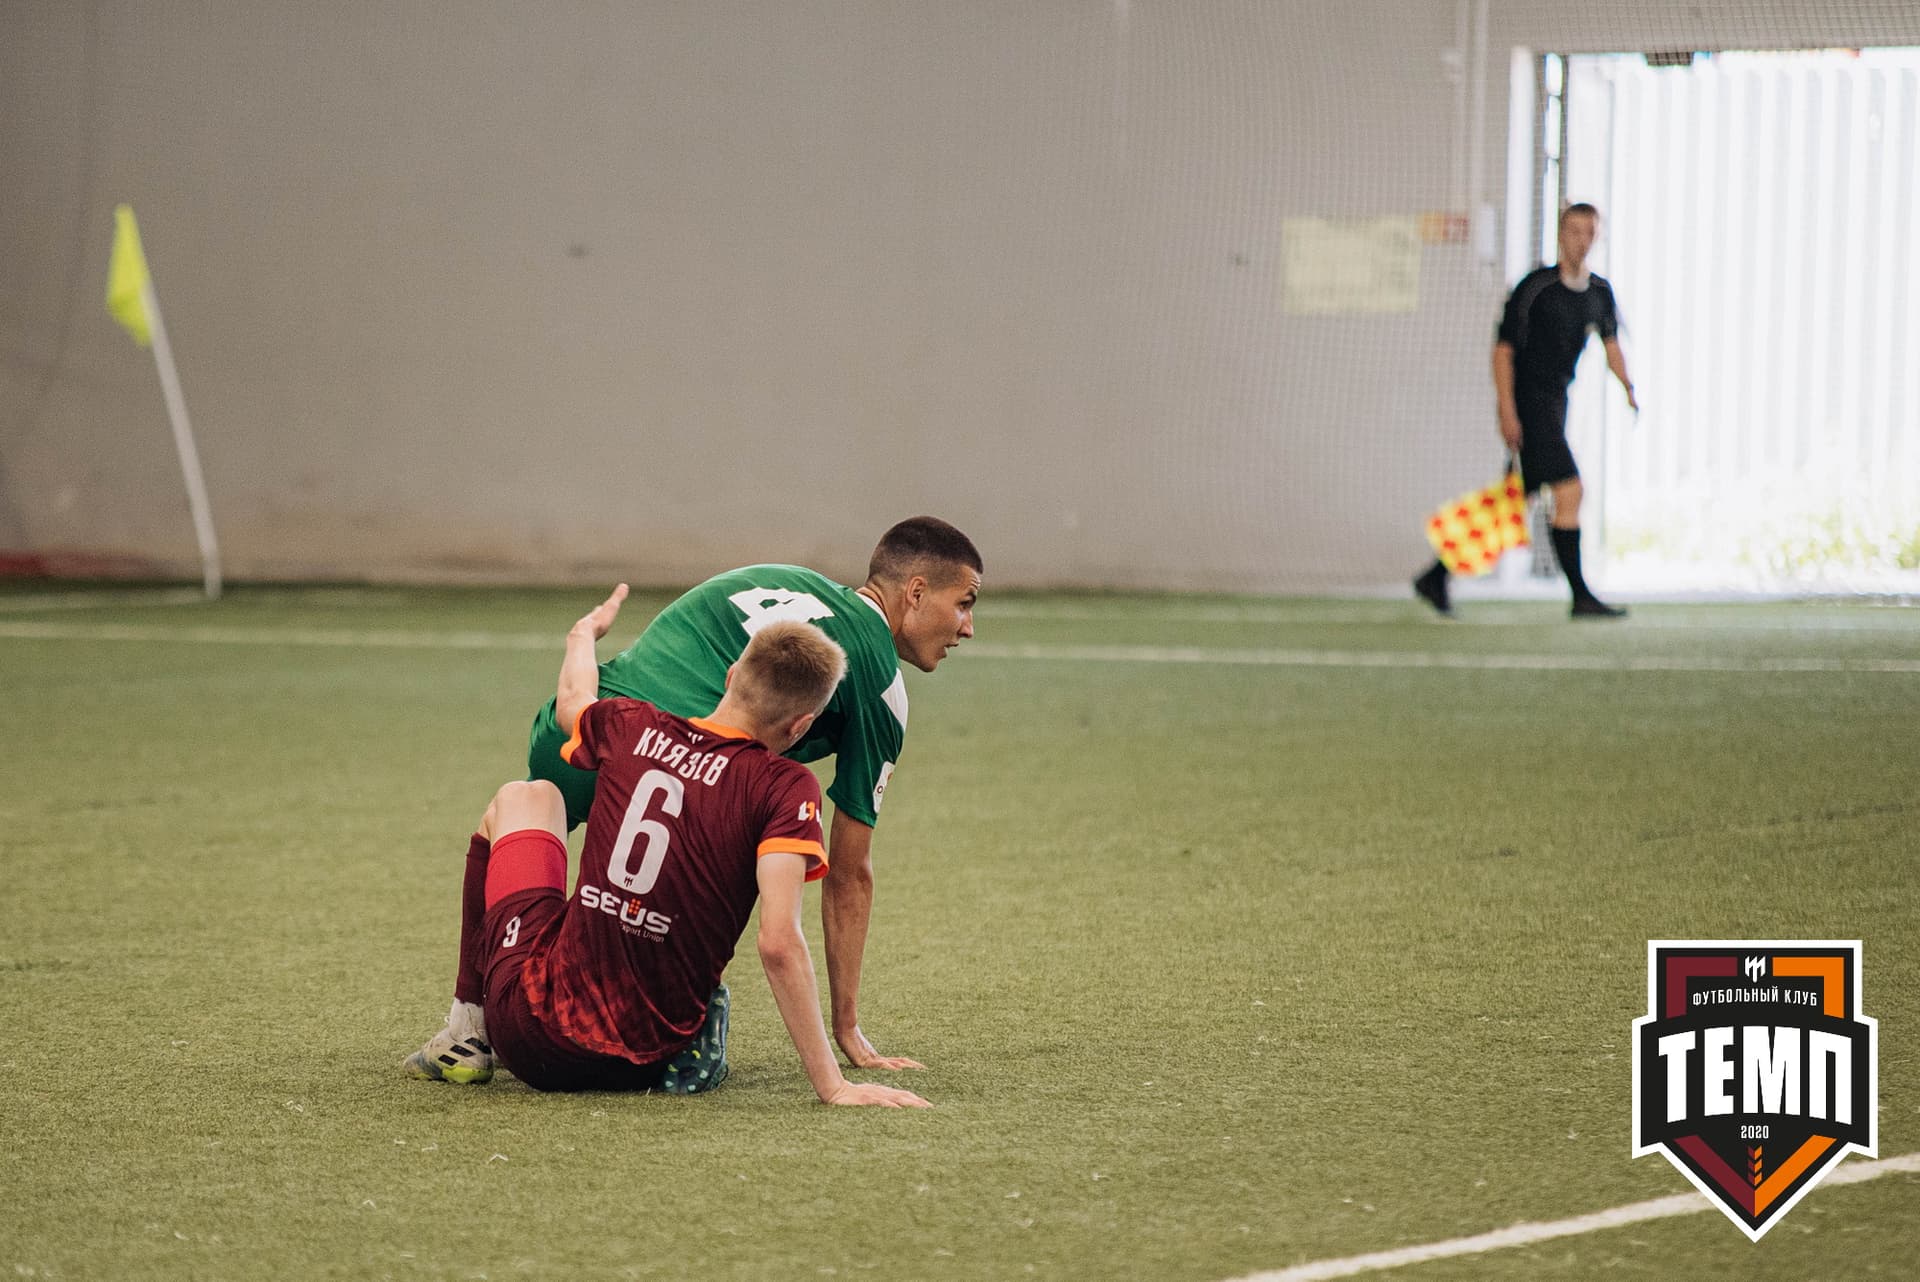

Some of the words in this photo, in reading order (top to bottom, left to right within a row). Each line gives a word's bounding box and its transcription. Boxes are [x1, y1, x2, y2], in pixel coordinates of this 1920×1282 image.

[728, 587, 835, 637] 4
[633, 727, 729, 786] КНЯЗЕВ
[606, 769, 685, 895] 6
